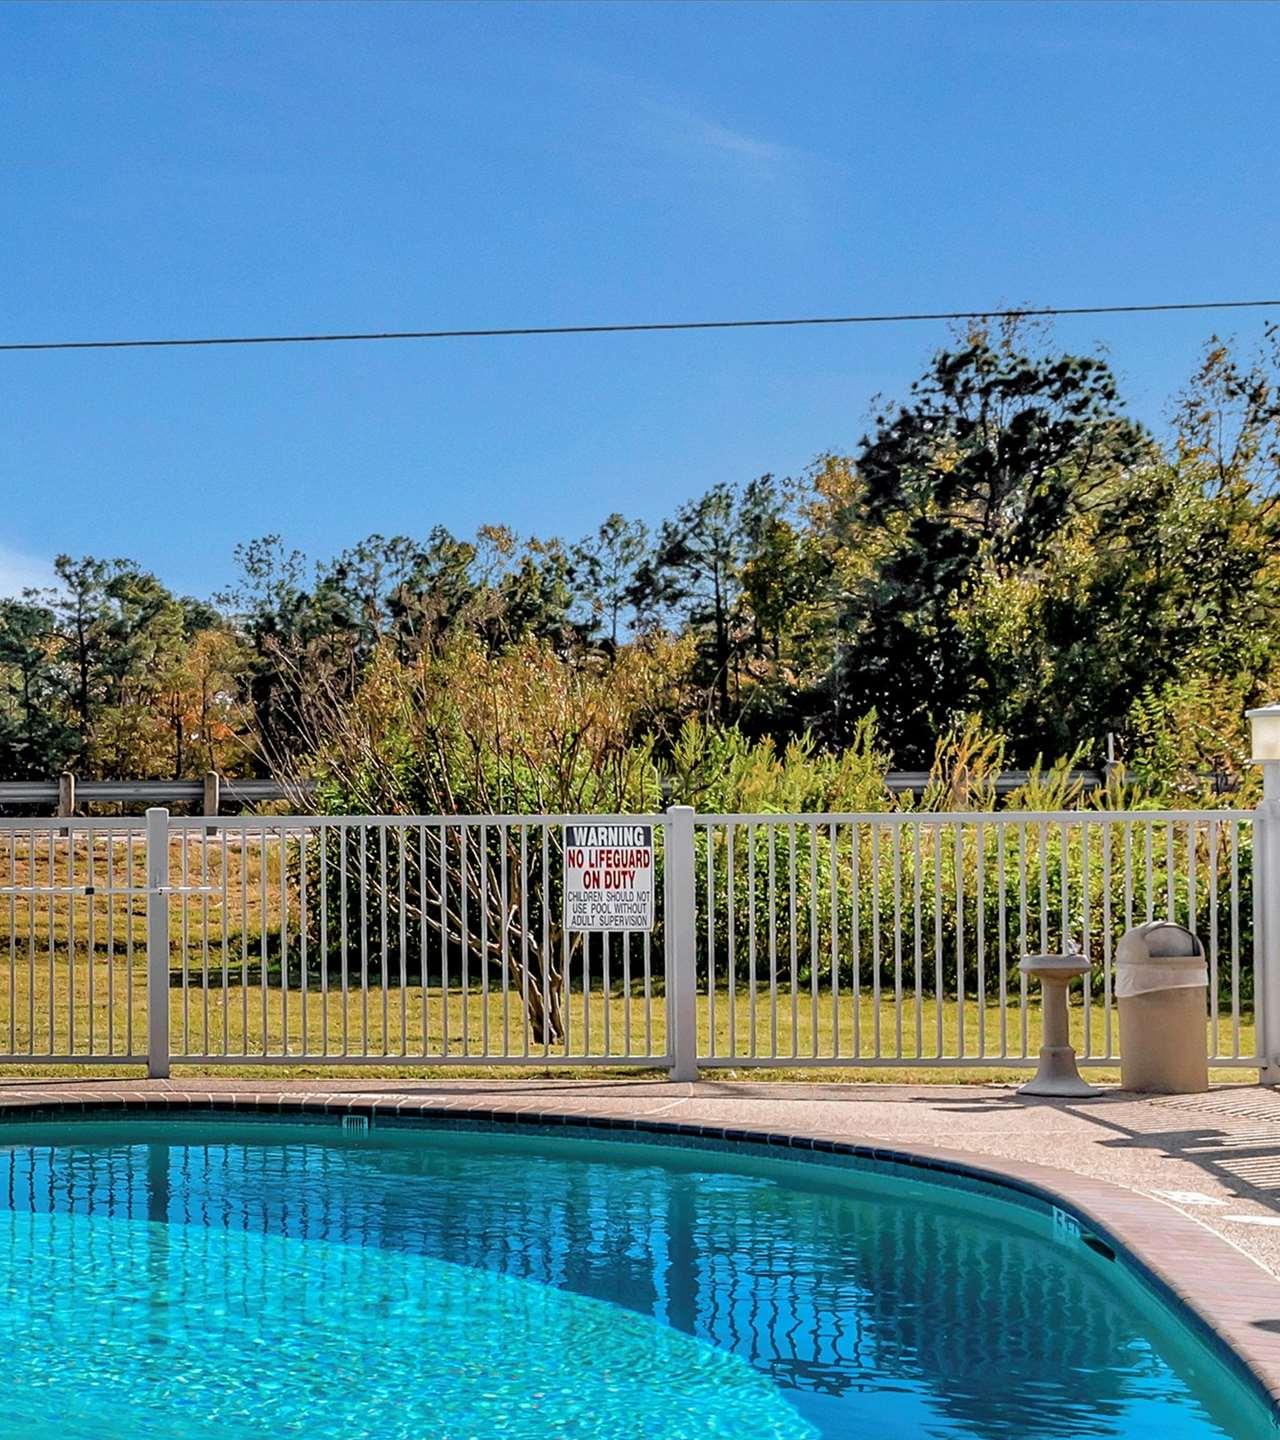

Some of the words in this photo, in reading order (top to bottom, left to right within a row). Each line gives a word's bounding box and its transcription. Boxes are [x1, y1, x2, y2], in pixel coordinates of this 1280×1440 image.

[573, 826, 645, 847] WARNING
[568, 849, 584, 868] NO
[589, 849, 650, 868] LIFEGUARD
[583, 870, 600, 889] ON
[604, 870, 636, 889] DUTY
[568, 891, 603, 902] CHILDREN
[606, 891, 634, 902] SHOULD
[637, 891, 650, 902] NOT
[572, 903, 588, 914] USE
[591, 903, 612, 914] POOL
[614, 903, 647, 914] WITHOUT
[571, 915, 595, 926] ADULT
[599, 915, 648, 926] SUPERVISION
